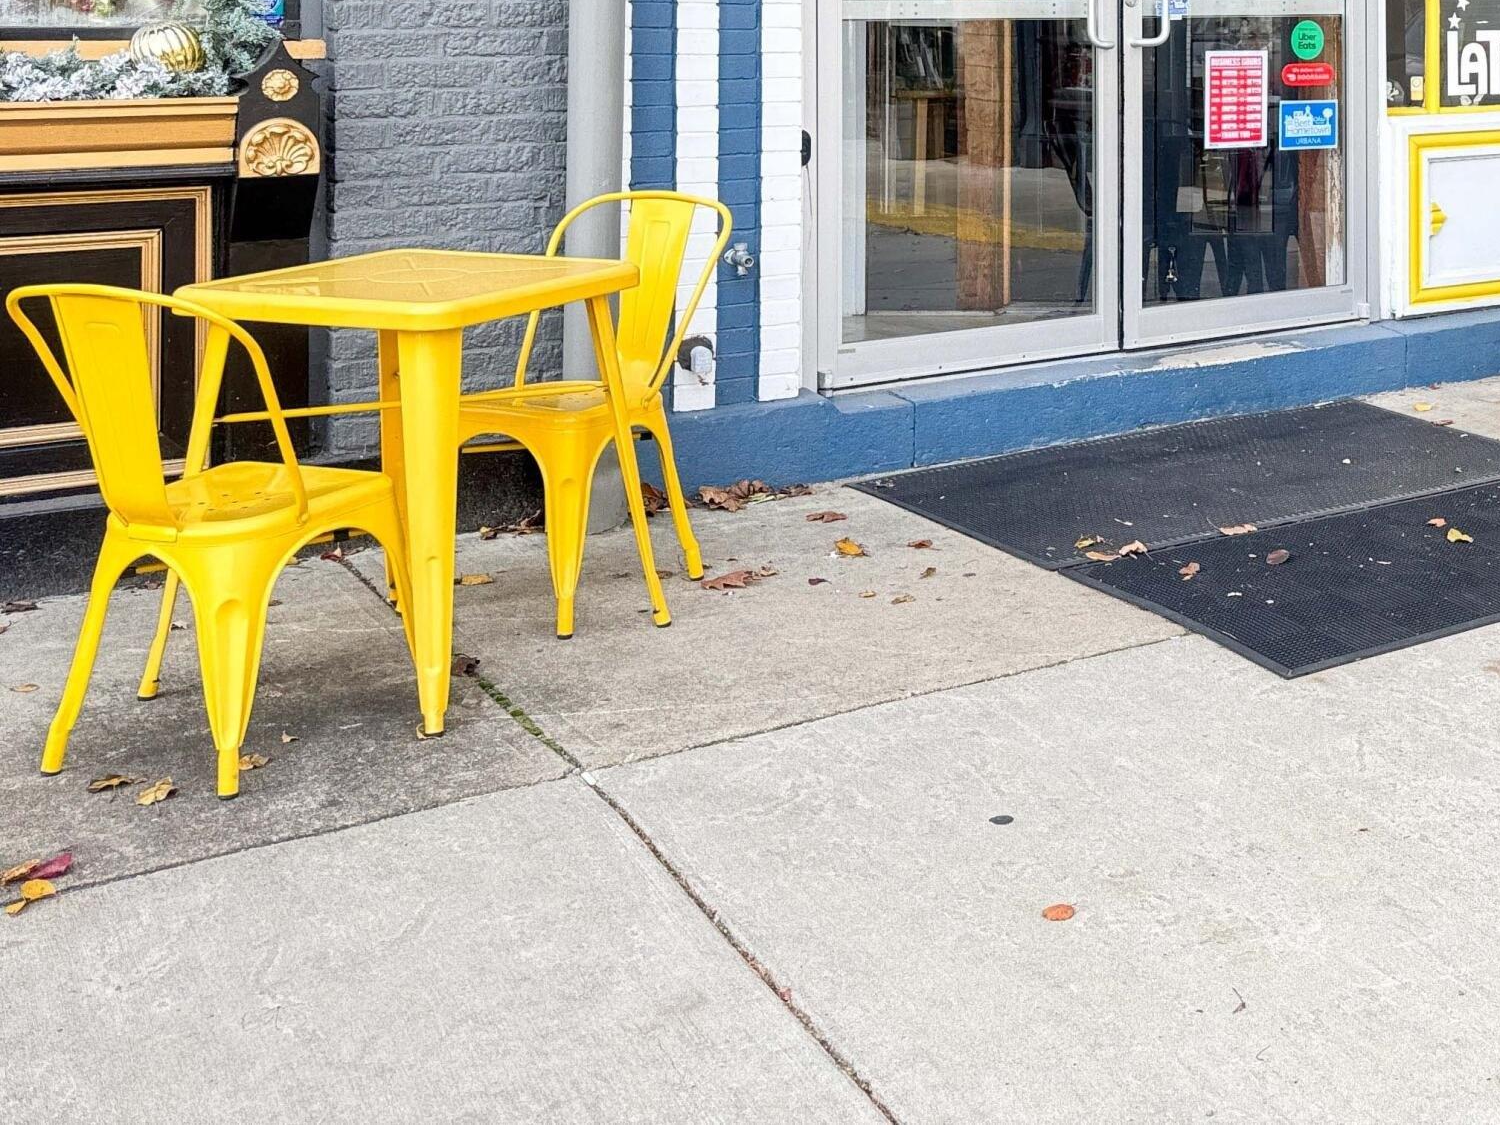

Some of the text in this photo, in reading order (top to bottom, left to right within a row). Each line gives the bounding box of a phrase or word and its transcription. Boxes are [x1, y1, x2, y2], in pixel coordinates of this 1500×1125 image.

[1298, 32, 1316, 41] Uber
[1298, 41, 1316, 50] Eats
[1294, 117, 1311, 128] Best
[1286, 126, 1330, 136] Hometown
[1295, 137, 1321, 145] URBANA
